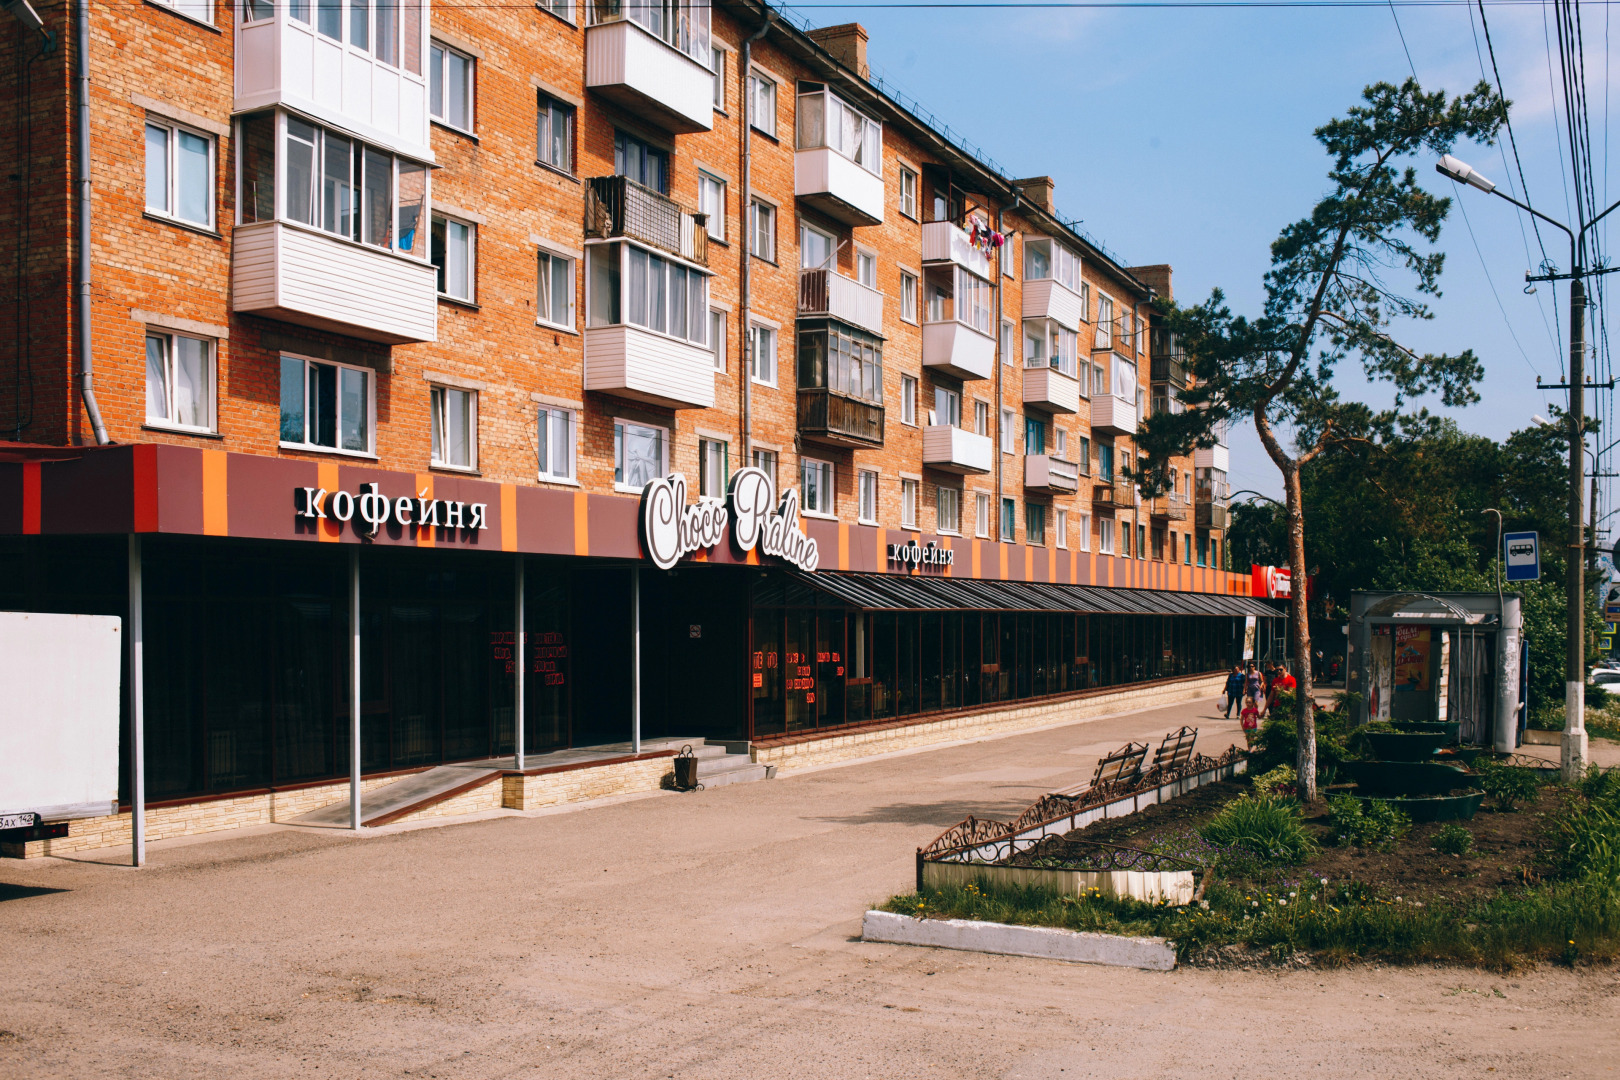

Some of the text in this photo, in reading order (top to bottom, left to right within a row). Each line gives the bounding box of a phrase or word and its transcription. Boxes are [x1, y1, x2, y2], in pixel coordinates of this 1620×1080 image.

[303, 482, 489, 535] кофейня
[648, 468, 818, 571] Choco Praline
[893, 539, 955, 570] кофейня
[19, 814, 32, 823] 142
